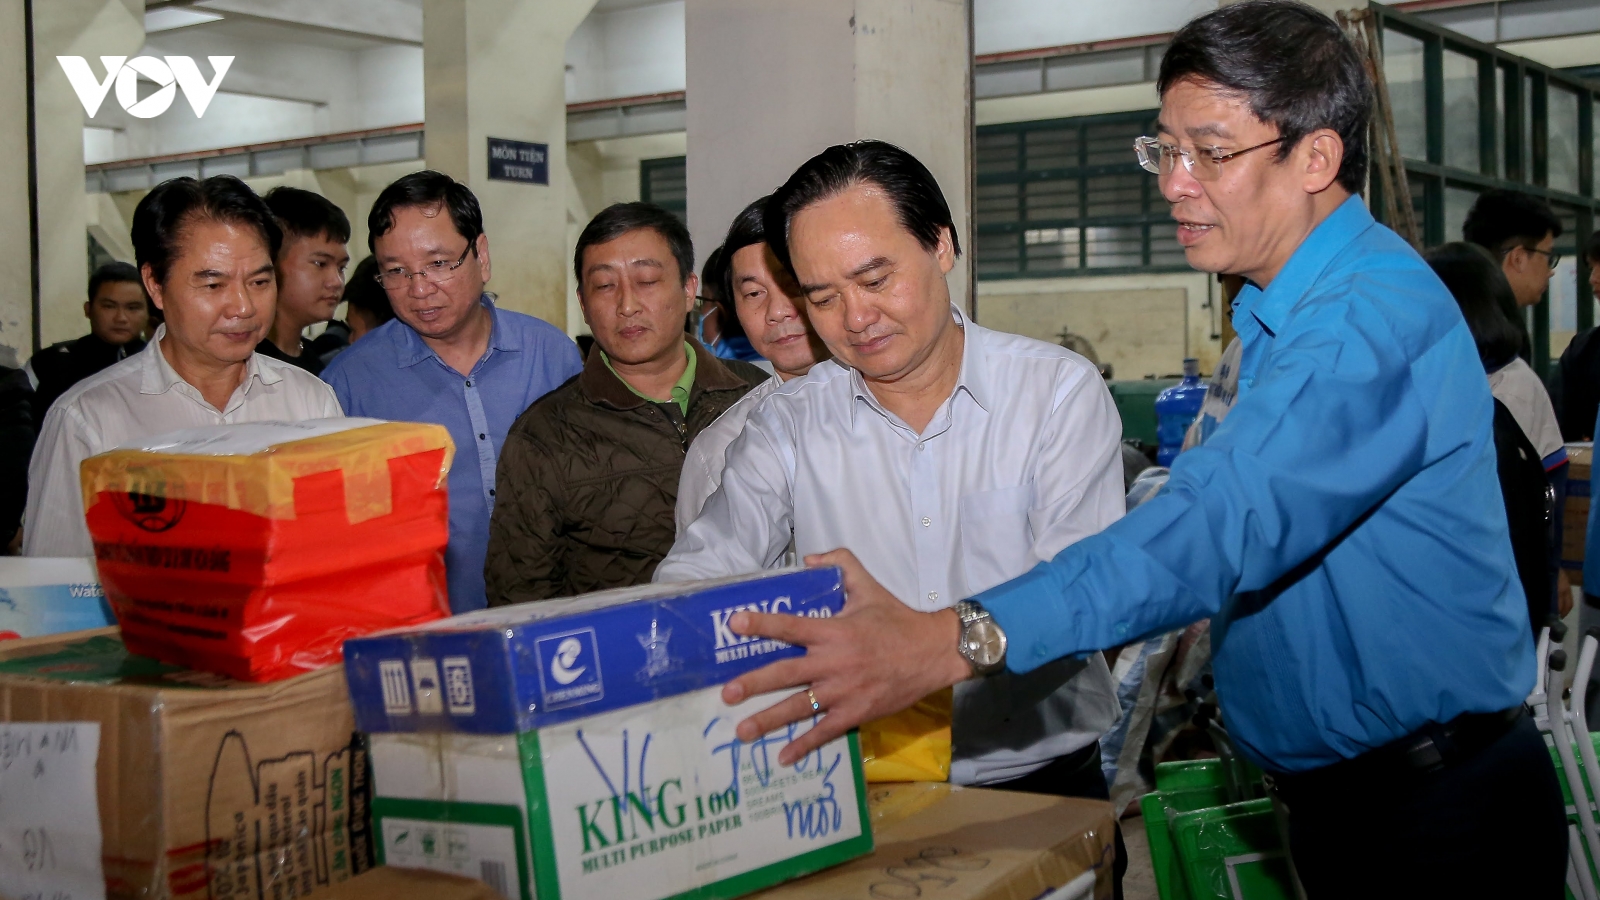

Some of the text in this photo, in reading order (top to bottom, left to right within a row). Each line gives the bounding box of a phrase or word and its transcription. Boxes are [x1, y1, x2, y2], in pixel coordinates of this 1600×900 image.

[491, 145, 517, 160] MÔN
[503, 164, 534, 179] TURN
[69, 586, 105, 598] Wate
[575, 777, 740, 855] KING 100
[581, 813, 742, 875] MULTI PURPOSE PAPER
